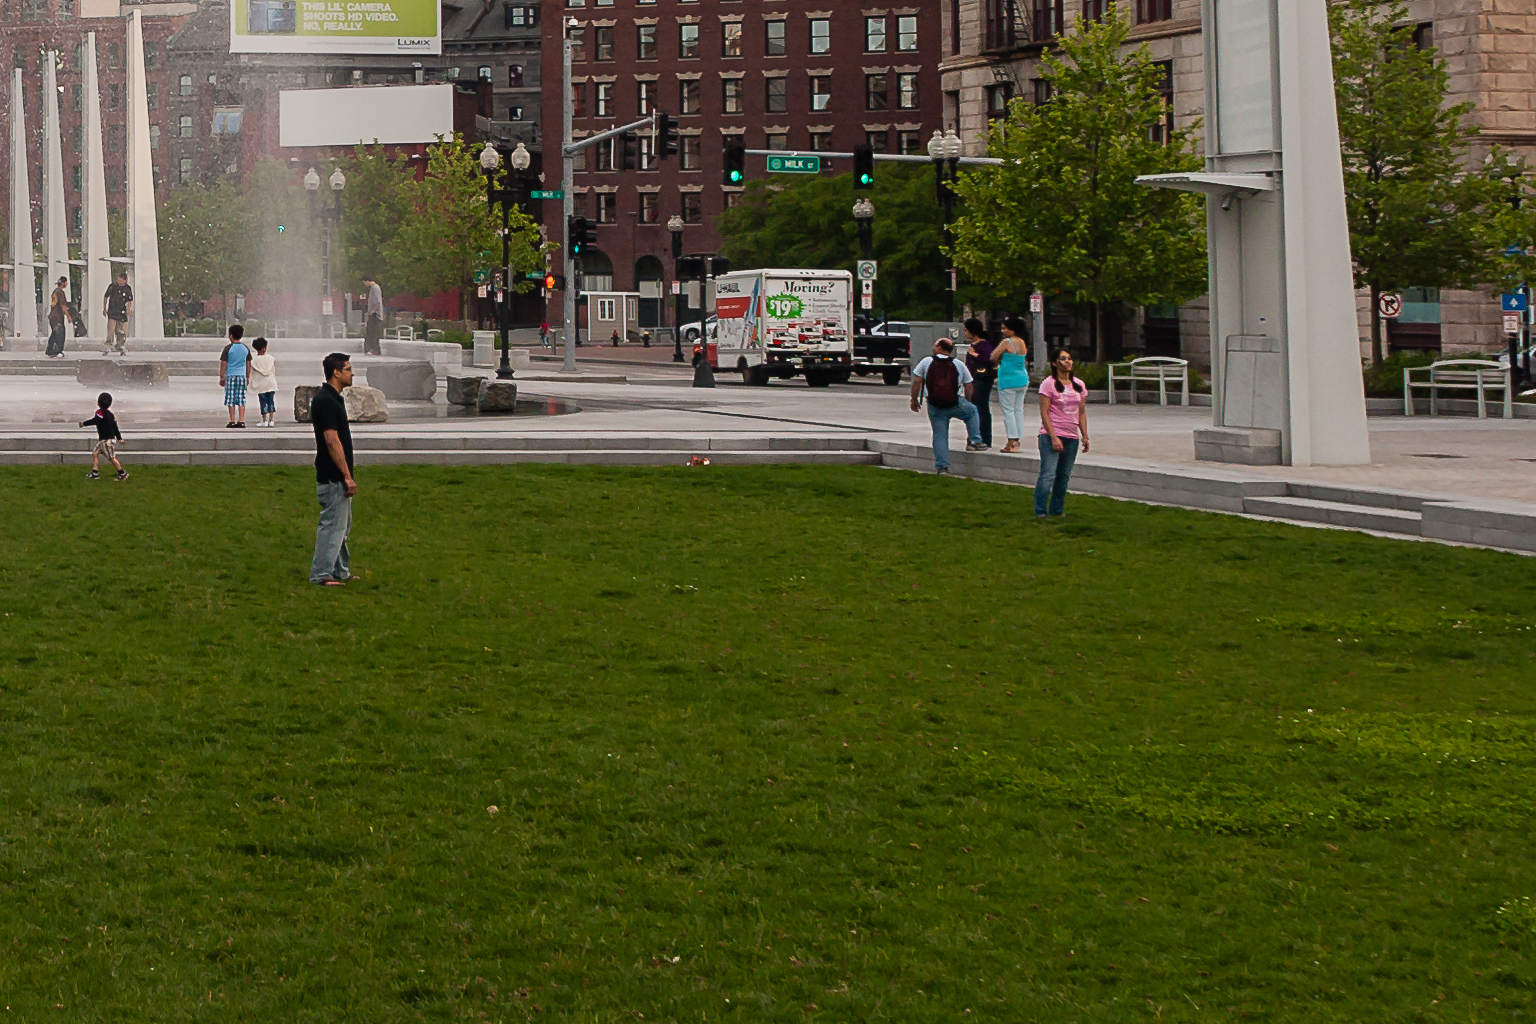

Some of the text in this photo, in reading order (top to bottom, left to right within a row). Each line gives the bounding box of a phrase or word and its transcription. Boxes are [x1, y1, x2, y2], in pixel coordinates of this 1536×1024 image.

[302, 2, 392, 12] THIS LIL' CAMERA
[303, 12, 399, 21] SHOOTS HD VIDEO.
[303, 22, 364, 31] NO, REALLY.
[785, 160, 804, 169] MILK
[783, 281, 835, 295] Moving?
